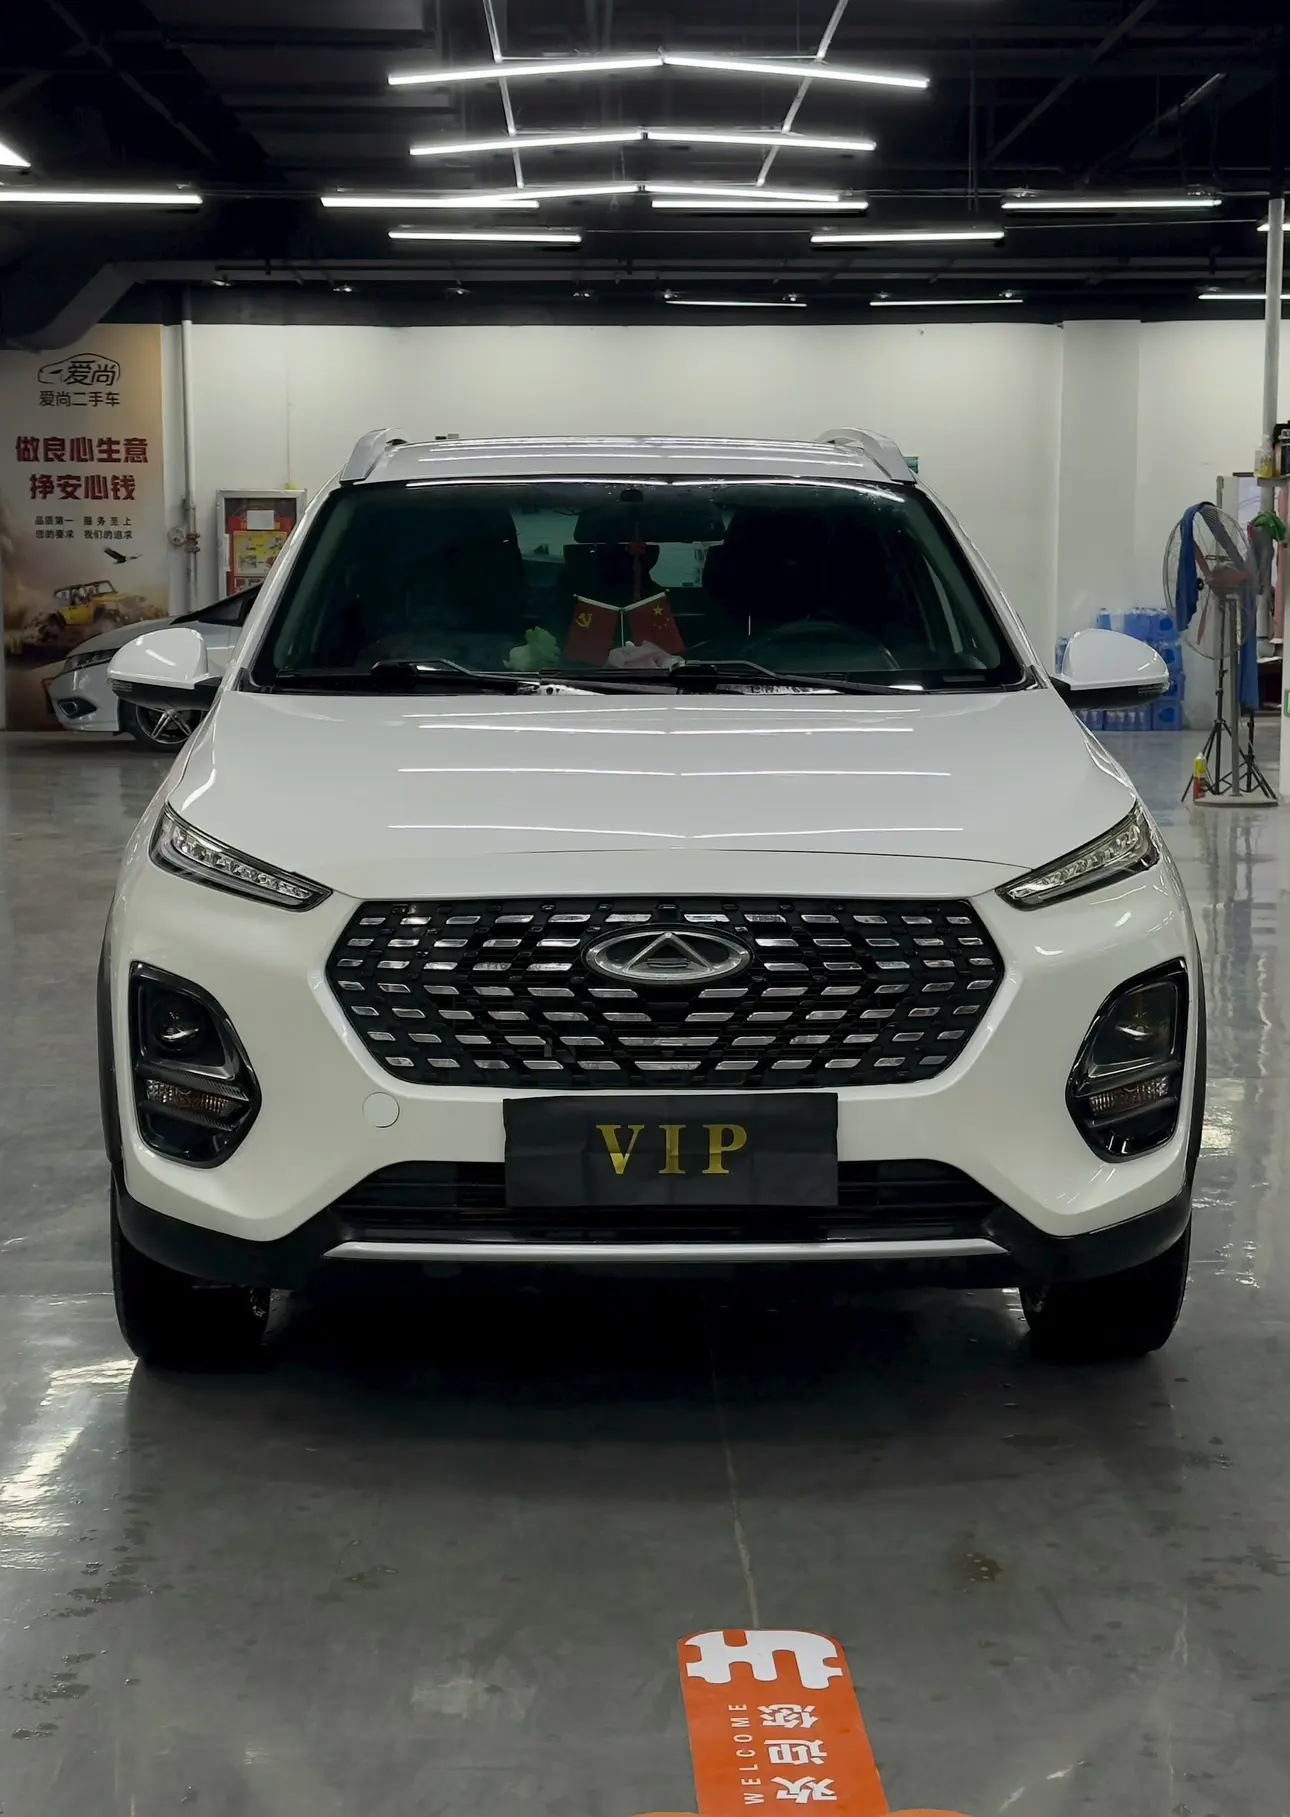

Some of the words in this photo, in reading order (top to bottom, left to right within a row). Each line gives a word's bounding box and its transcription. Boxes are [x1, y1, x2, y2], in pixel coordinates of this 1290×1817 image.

[63, 360, 117, 386] 爱尚
[39, 391, 120, 407] 爱尚二手车
[16, 436, 148, 463] 做良心生意
[29, 474, 135, 500] 挣安心钱
[34, 516, 75, 526] 品质第一
[35, 529, 74, 539] 您的要求
[84, 529, 132, 540] 我们的追求
[595, 1124, 748, 1175] VIP
[728, 1703, 765, 1805] WELCOME
[757, 1703, 838, 1804] 欢迎您
